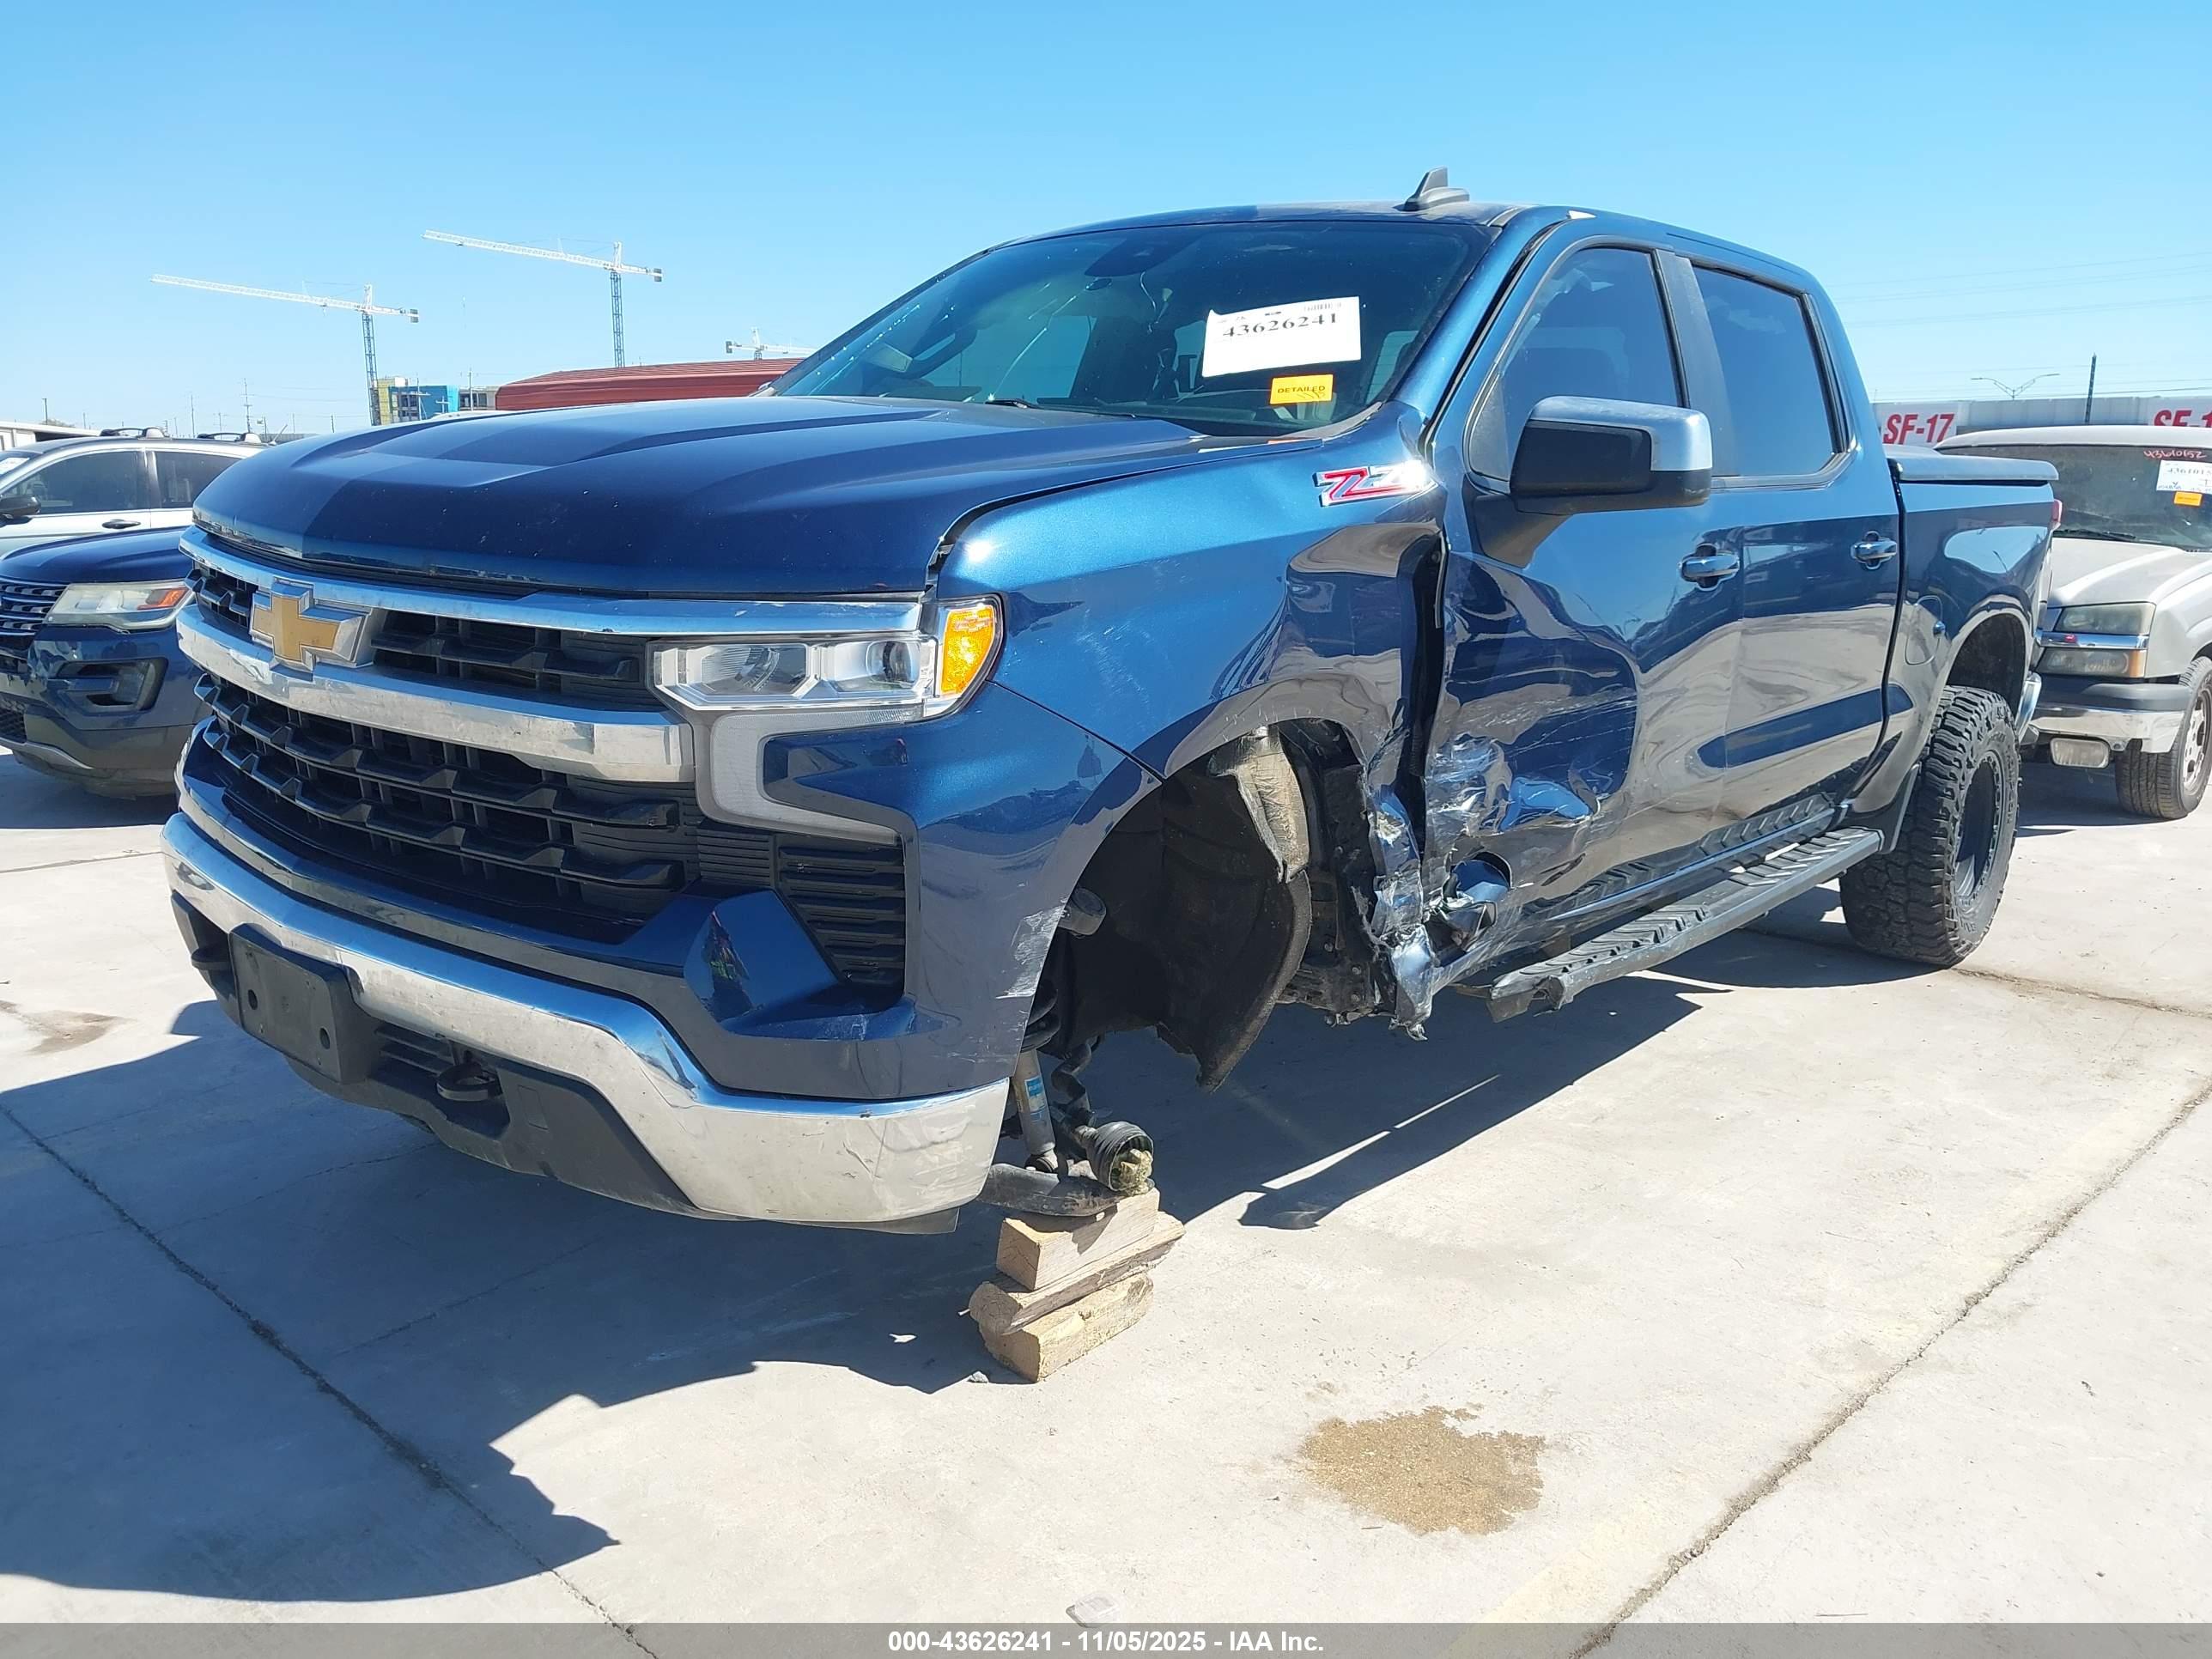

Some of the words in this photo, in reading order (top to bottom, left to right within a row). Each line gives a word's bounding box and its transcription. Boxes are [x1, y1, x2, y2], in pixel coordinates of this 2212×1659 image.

[1222, 313, 1337, 337] 43626241
[1277, 385, 1326, 394] DETAILED
[1882, 413, 1955, 445] SF-17
